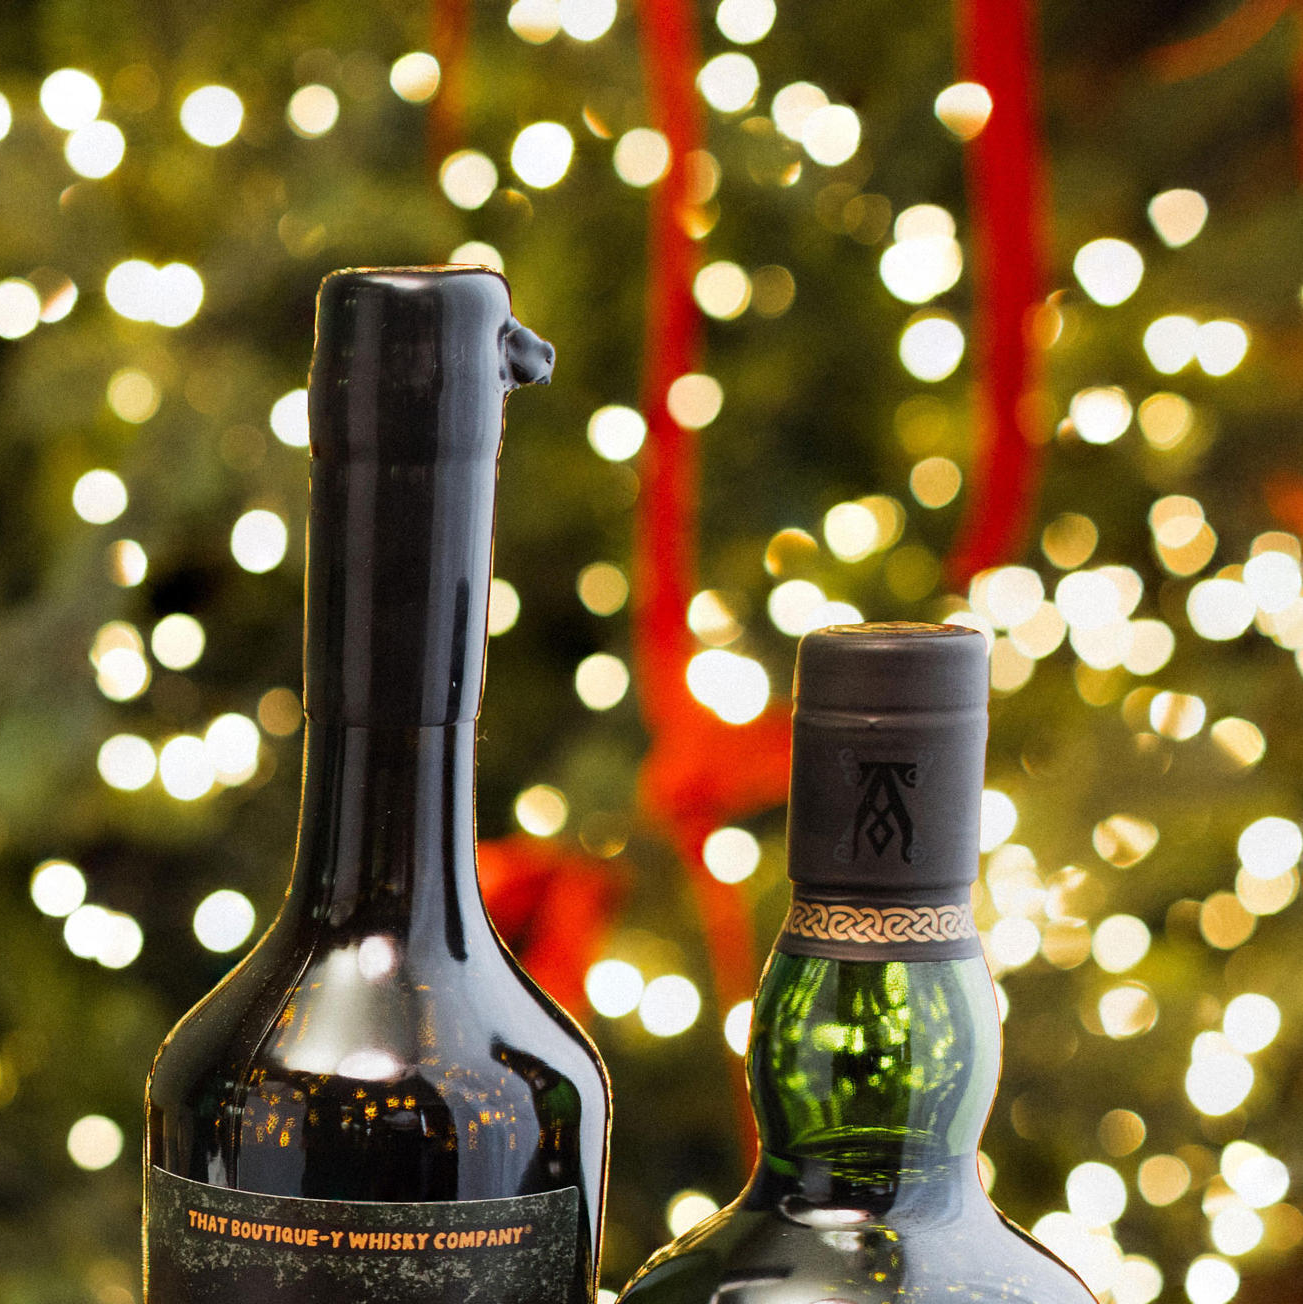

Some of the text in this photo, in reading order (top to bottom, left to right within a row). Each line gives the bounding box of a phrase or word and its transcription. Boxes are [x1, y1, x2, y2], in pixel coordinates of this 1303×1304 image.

[189, 1211, 227, 1235] THAT
[231, 1221, 343, 1250] BOUTIQUE-Y
[349, 1232, 427, 1250] WHISKY
